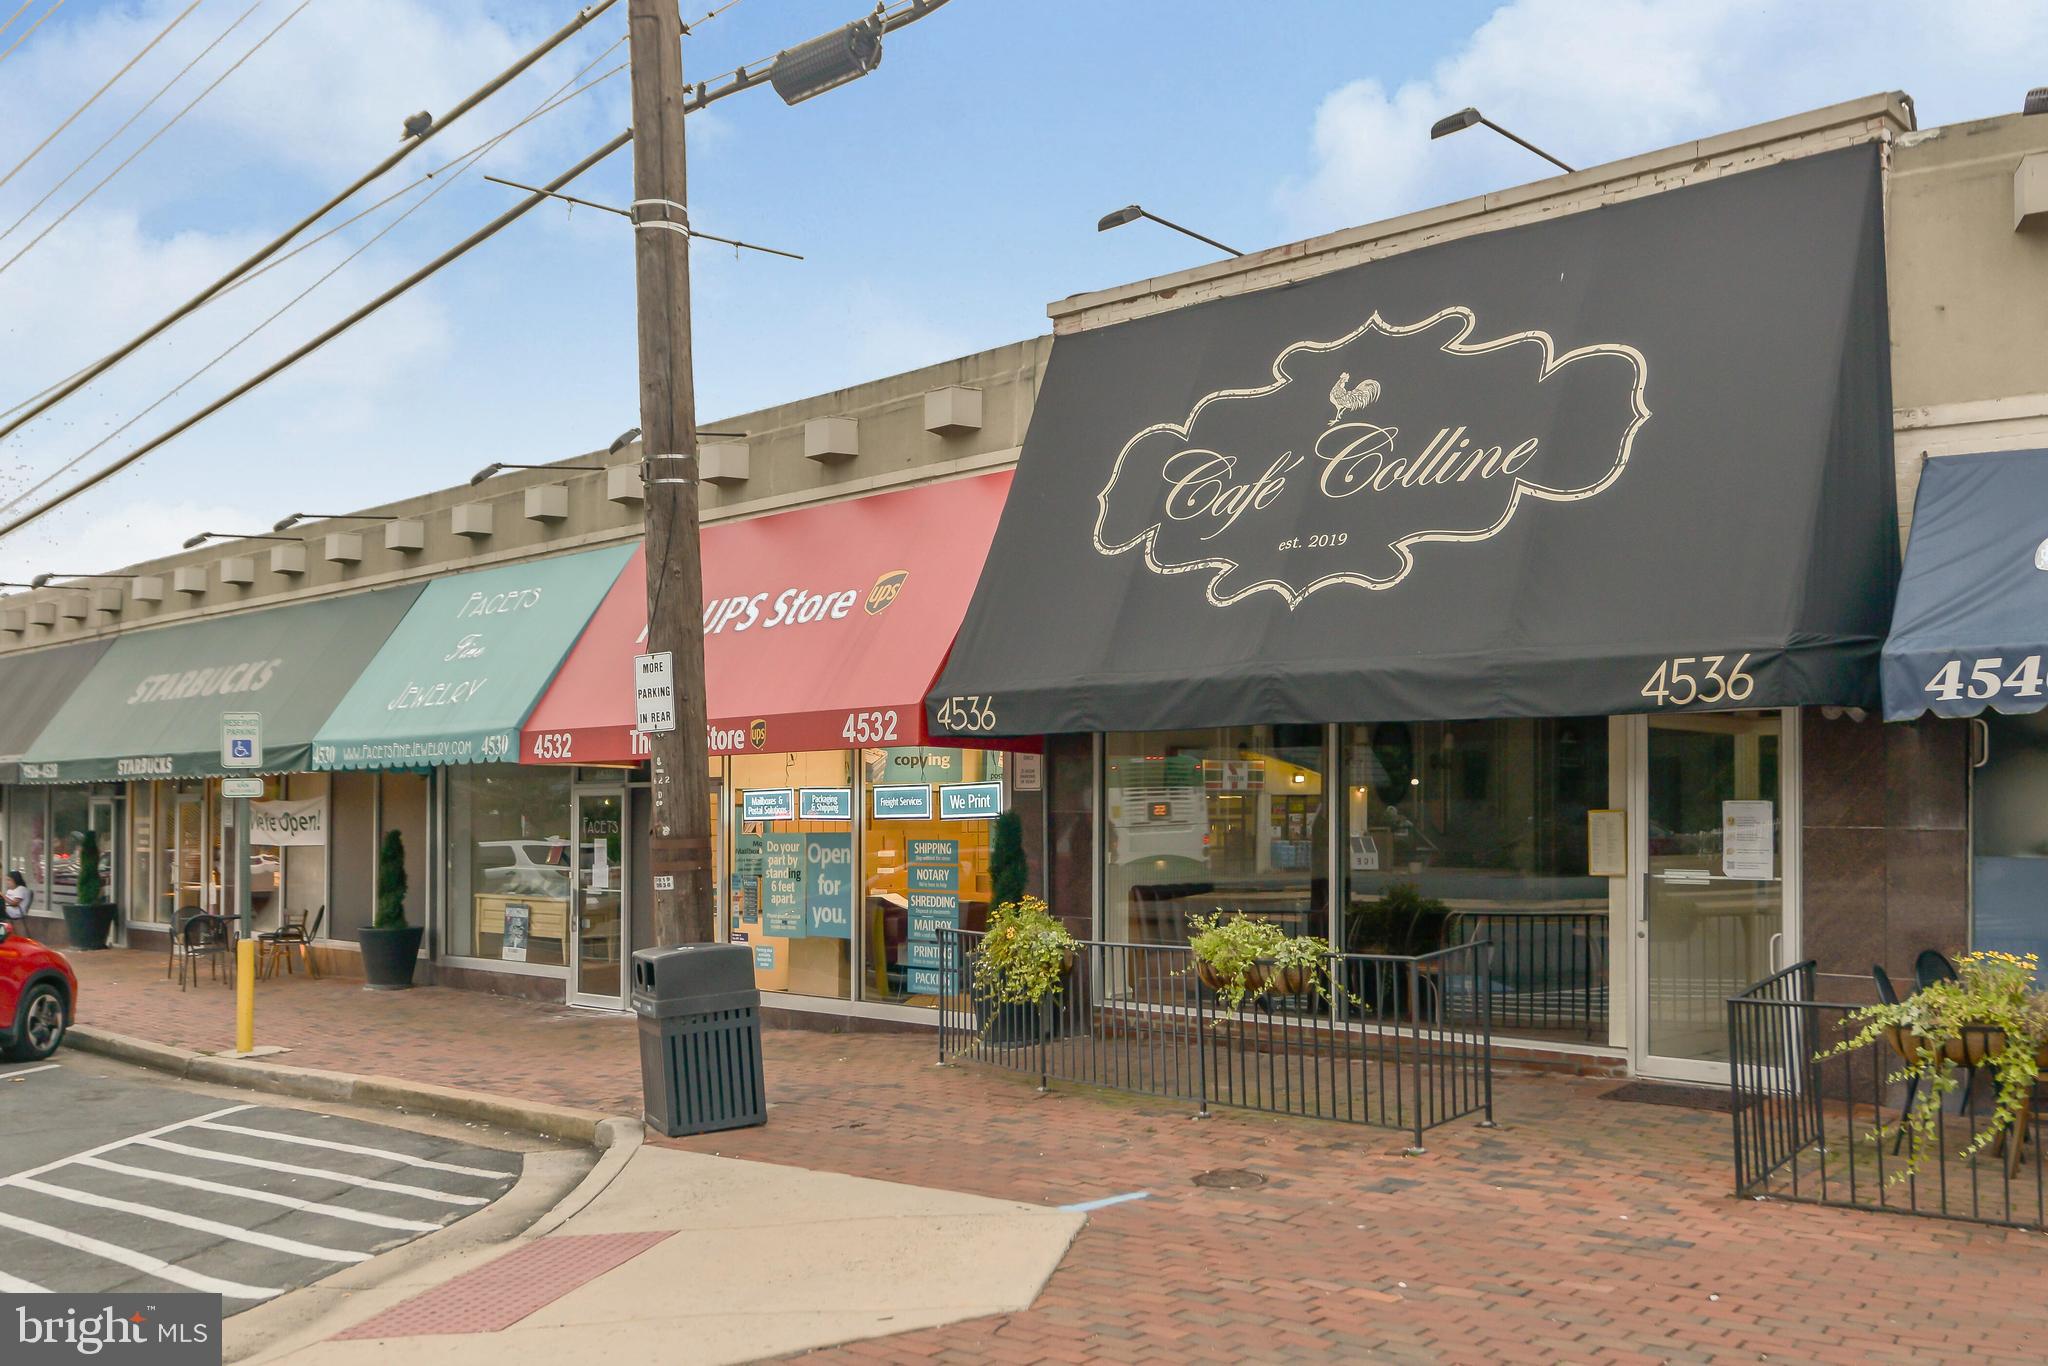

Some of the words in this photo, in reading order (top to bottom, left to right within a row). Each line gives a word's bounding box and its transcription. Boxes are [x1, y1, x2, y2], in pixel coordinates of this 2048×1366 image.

[1162, 449, 1304, 541] Café
[1314, 422, 1539, 499] Colline
[1278, 536, 1303, 551] est.
[1308, 533, 1348, 548] 2019
[869, 583, 901, 608] ups
[703, 592, 769, 635] UPS
[763, 588, 858, 629] Store
[444, 633, 486, 662] Fine
[642, 661, 664, 674] MORE
[127, 658, 282, 704] STARBUCKS
[1640, 653, 1754, 706] 4536
[1924, 655, 2048, 701] 454
[638, 686, 671, 700] PARKING
[640, 713, 649, 724] IN
[650, 711, 671, 723] REAR
[937, 695, 996, 731] 4536
[751, 727, 766, 741] ups
[842, 710, 898, 743] 4532
[482, 735, 509, 756] 4530
[533, 732, 572, 759] 4532
[630, 729, 651, 755] Th
[312, 745, 336, 764] 4530
[894, 753, 951, 768] copying
[117, 757, 172, 775] STARBUCKS
[778, 796, 783, 804] &
[880, 797, 898, 808] Freight
[900, 796, 923, 806] Services
[950, 795, 965, 809] We
[968, 794, 991, 809] Print
[748, 806, 763, 816] Postal
[583, 816, 619, 835] FACETS
[767, 840, 778, 852] Do
[780, 843, 800, 855] your
[807, 842, 851, 869] Open
[914, 842, 952, 855] SHIPPING
[768, 855, 786, 868] part
[787, 854, 798, 868] by
[766, 868, 801, 881] standing
[916, 869, 950, 881] NOTARY
[771, 880, 777, 892] 6
[778, 880, 795, 892] feet
[817, 873, 842, 896] for
[771, 894, 796, 906] apart.
[911, 895, 956, 908] SHREDDING
[812, 906, 847, 928] you.
